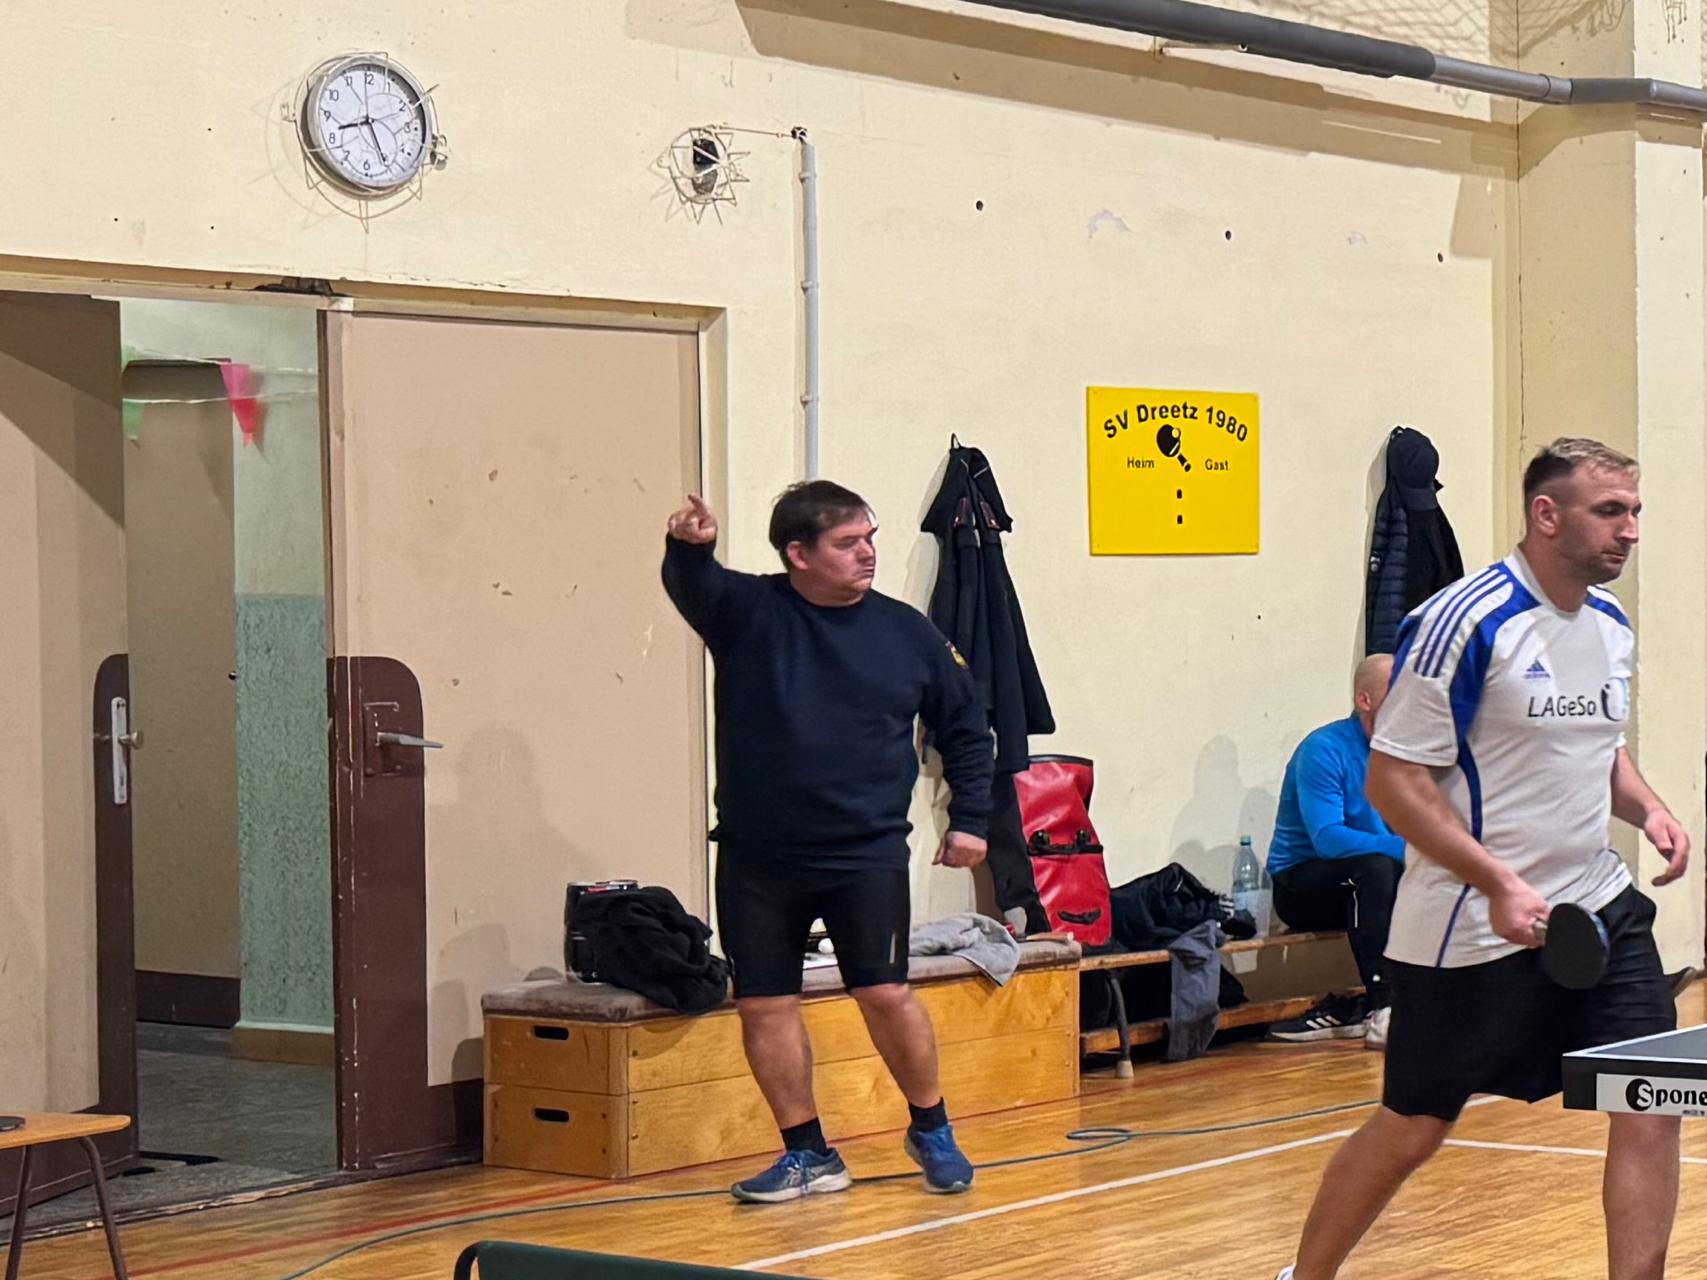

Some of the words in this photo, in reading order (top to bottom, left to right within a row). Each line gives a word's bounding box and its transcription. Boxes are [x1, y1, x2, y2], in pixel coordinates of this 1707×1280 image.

[328, 88, 340, 102] 10
[328, 131, 336, 145] 8
[362, 160, 371, 171] 6
[1103, 409, 1129, 439] SV
[1136, 401, 1199, 423] Dreetz
[1205, 406, 1248, 442] 1980
[1126, 456, 1155, 469] Heim
[1204, 458, 1229, 471] Gast
[1527, 694, 1597, 718] LAGeSo
